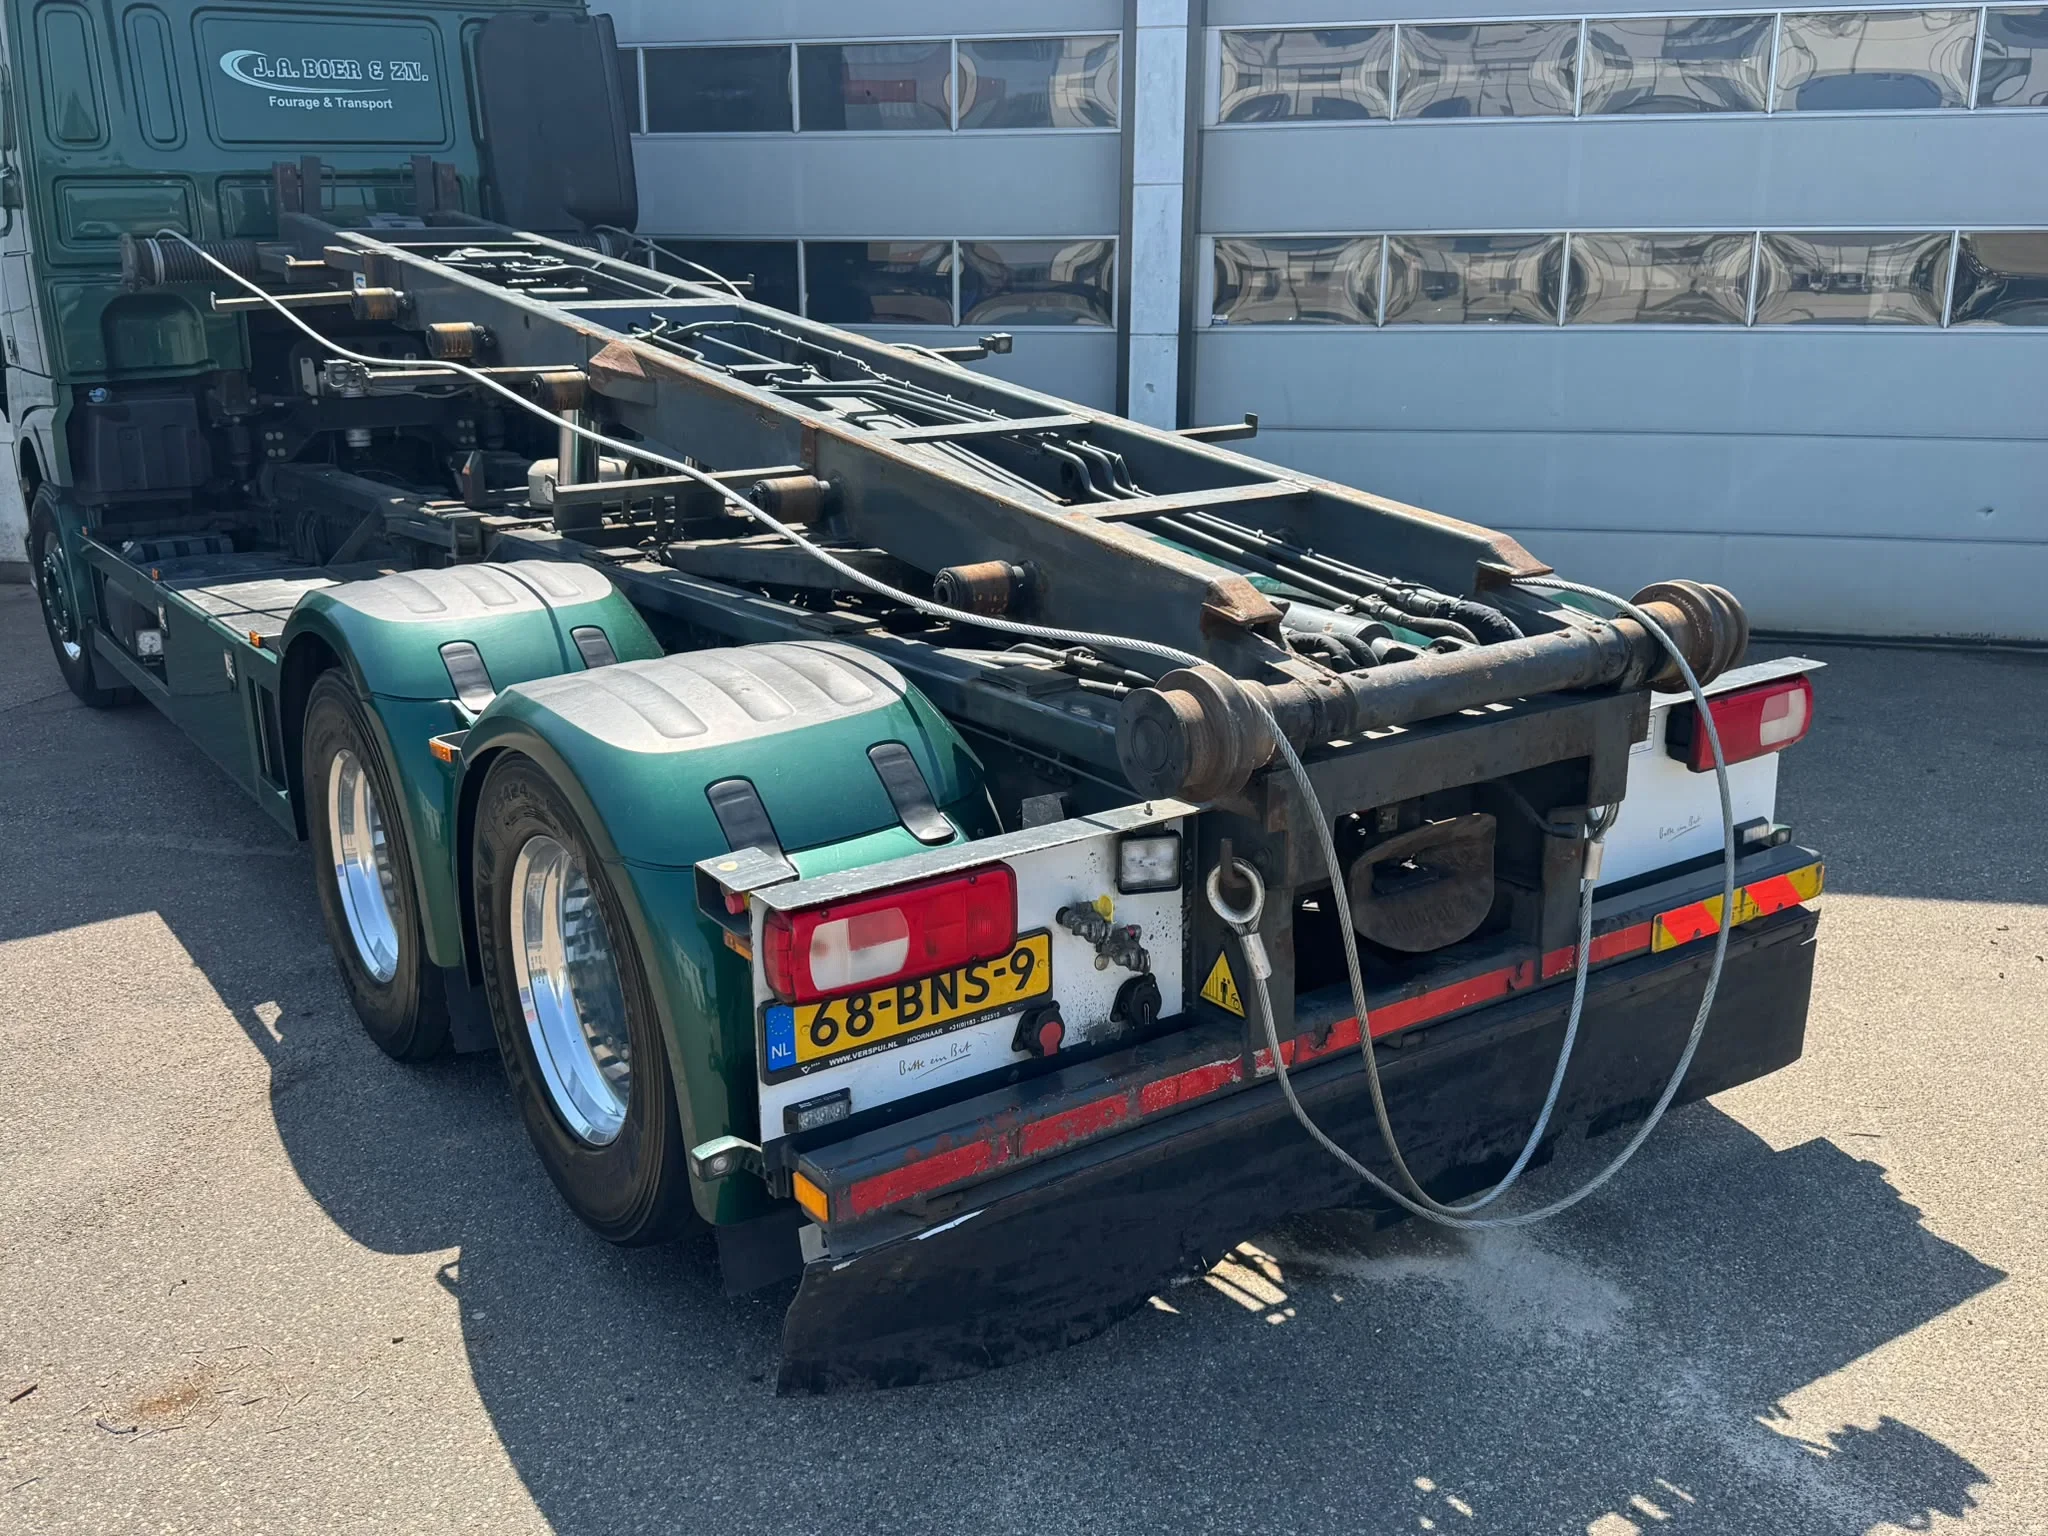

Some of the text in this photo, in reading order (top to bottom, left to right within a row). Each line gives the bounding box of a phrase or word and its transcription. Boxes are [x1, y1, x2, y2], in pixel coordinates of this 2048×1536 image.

[302, 58, 362, 79] BOER
[368, 60, 384, 80] &
[390, 61, 429, 82] ZN.
[269, 95, 393, 111] Fourage & Transport
[809, 946, 1035, 1048] 68-BNS-9
[771, 1042, 791, 1059] NL
[828, 1040, 899, 1067] WWW.VERSPUI.NL
[906, 1027, 944, 1044] HOORNAAR
[899, 1041, 972, 1076] Bitte ein Bit
